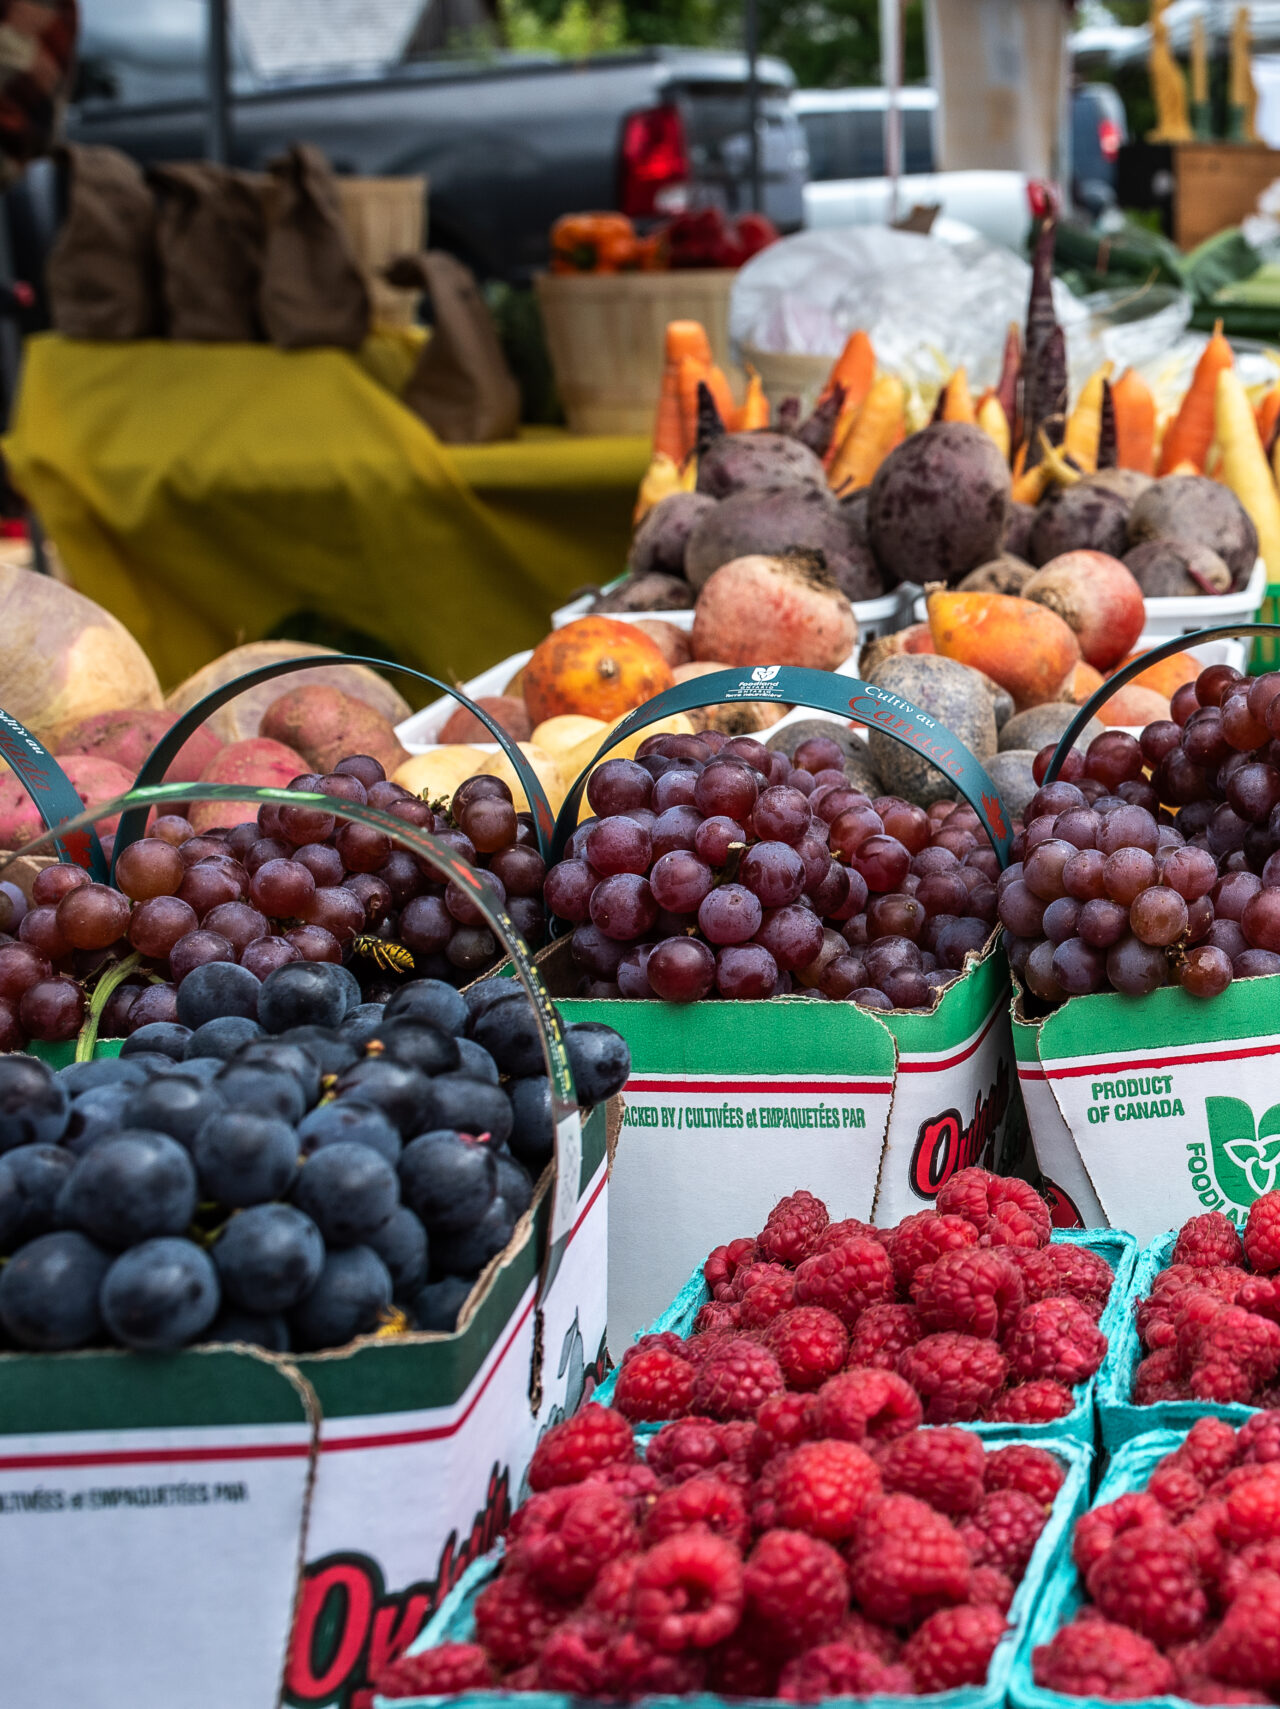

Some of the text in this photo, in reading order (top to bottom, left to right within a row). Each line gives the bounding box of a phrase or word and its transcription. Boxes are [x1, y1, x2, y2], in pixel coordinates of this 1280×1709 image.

[864, 686, 936, 729] Cultiv au
[25, 738, 45, 755] au
[848, 696, 965, 778] Canada
[1091, 1075, 1173, 1100] PRODUCT
[623, 1102, 867, 1130] ACKED BY / CULTIVÉES et EMPAQUETÉES PAR
[1087, 1098, 1185, 1124] OF CANADA
